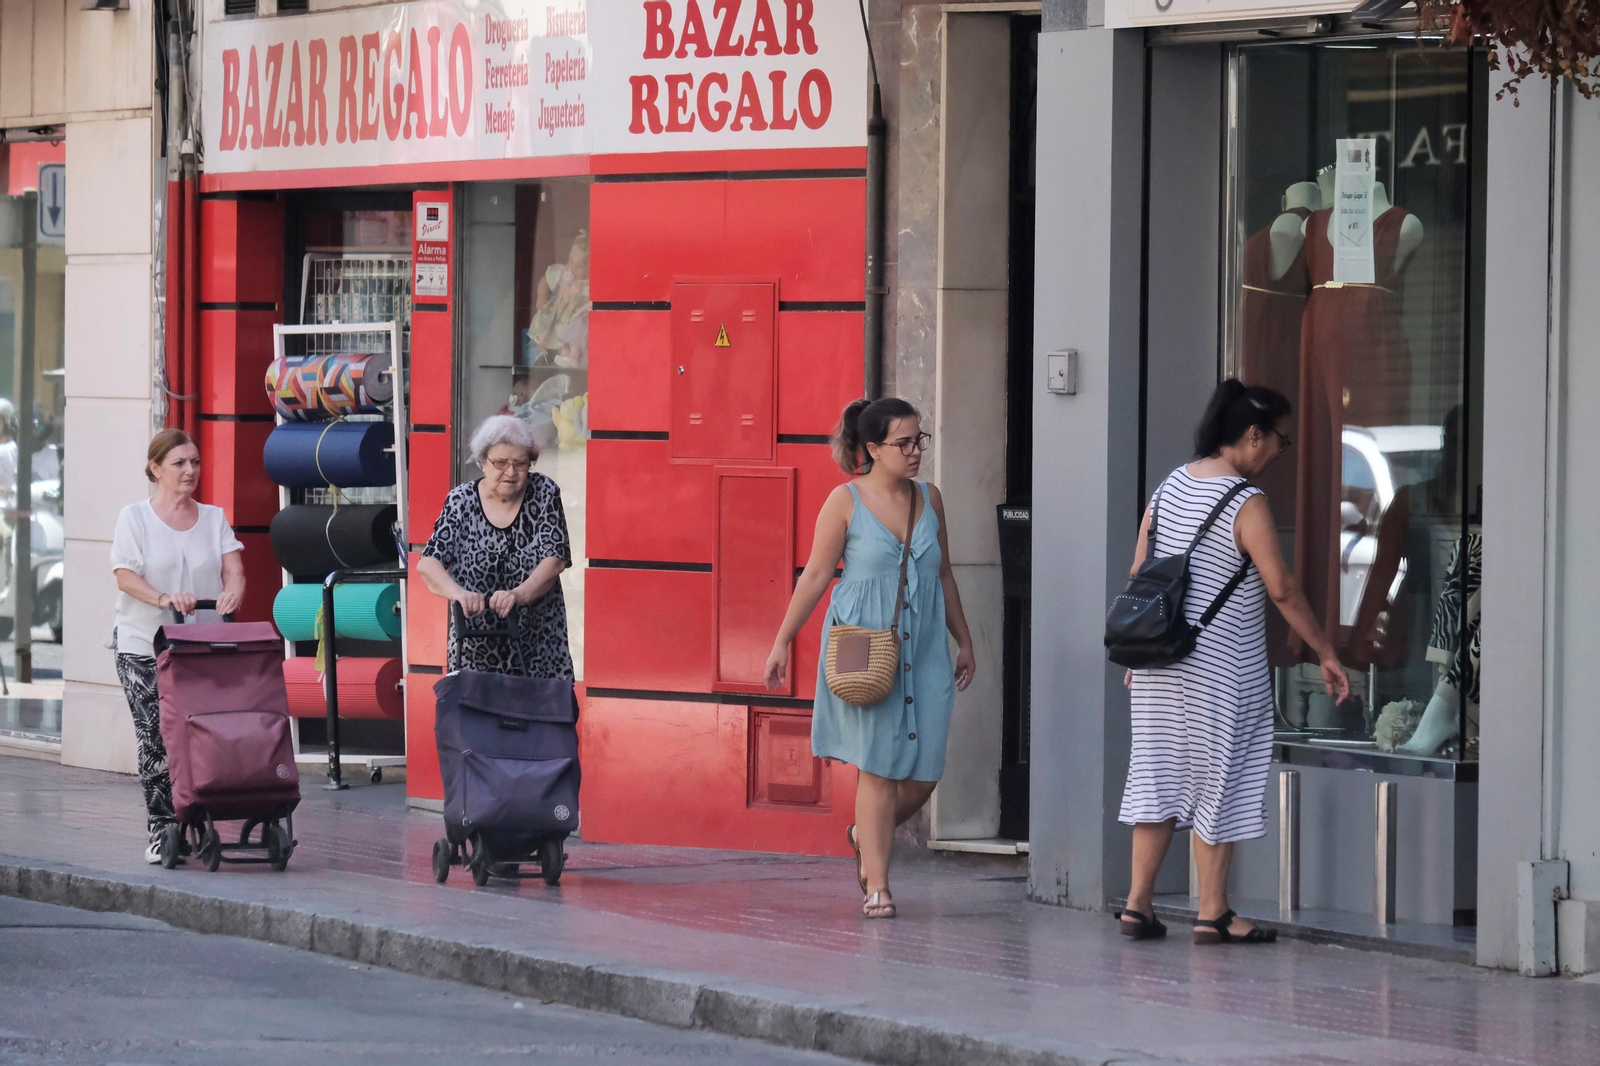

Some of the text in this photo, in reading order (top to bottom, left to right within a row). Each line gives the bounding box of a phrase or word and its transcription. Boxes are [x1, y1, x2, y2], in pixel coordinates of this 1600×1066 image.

[485, 8, 528, 51] Droguería
[546, 0, 586, 37] Bisutería
[643, 0, 818, 59] BAZAR
[219, 22, 473, 151] BAZAR REGALO
[485, 53, 529, 90] Ferretería
[545, 47, 586, 90] Papelería
[485, 101, 516, 140] Menaje
[537, 93, 585, 138] Juguetería
[628, 68, 833, 134] REGALO
[418, 243, 446, 254] Alarma
